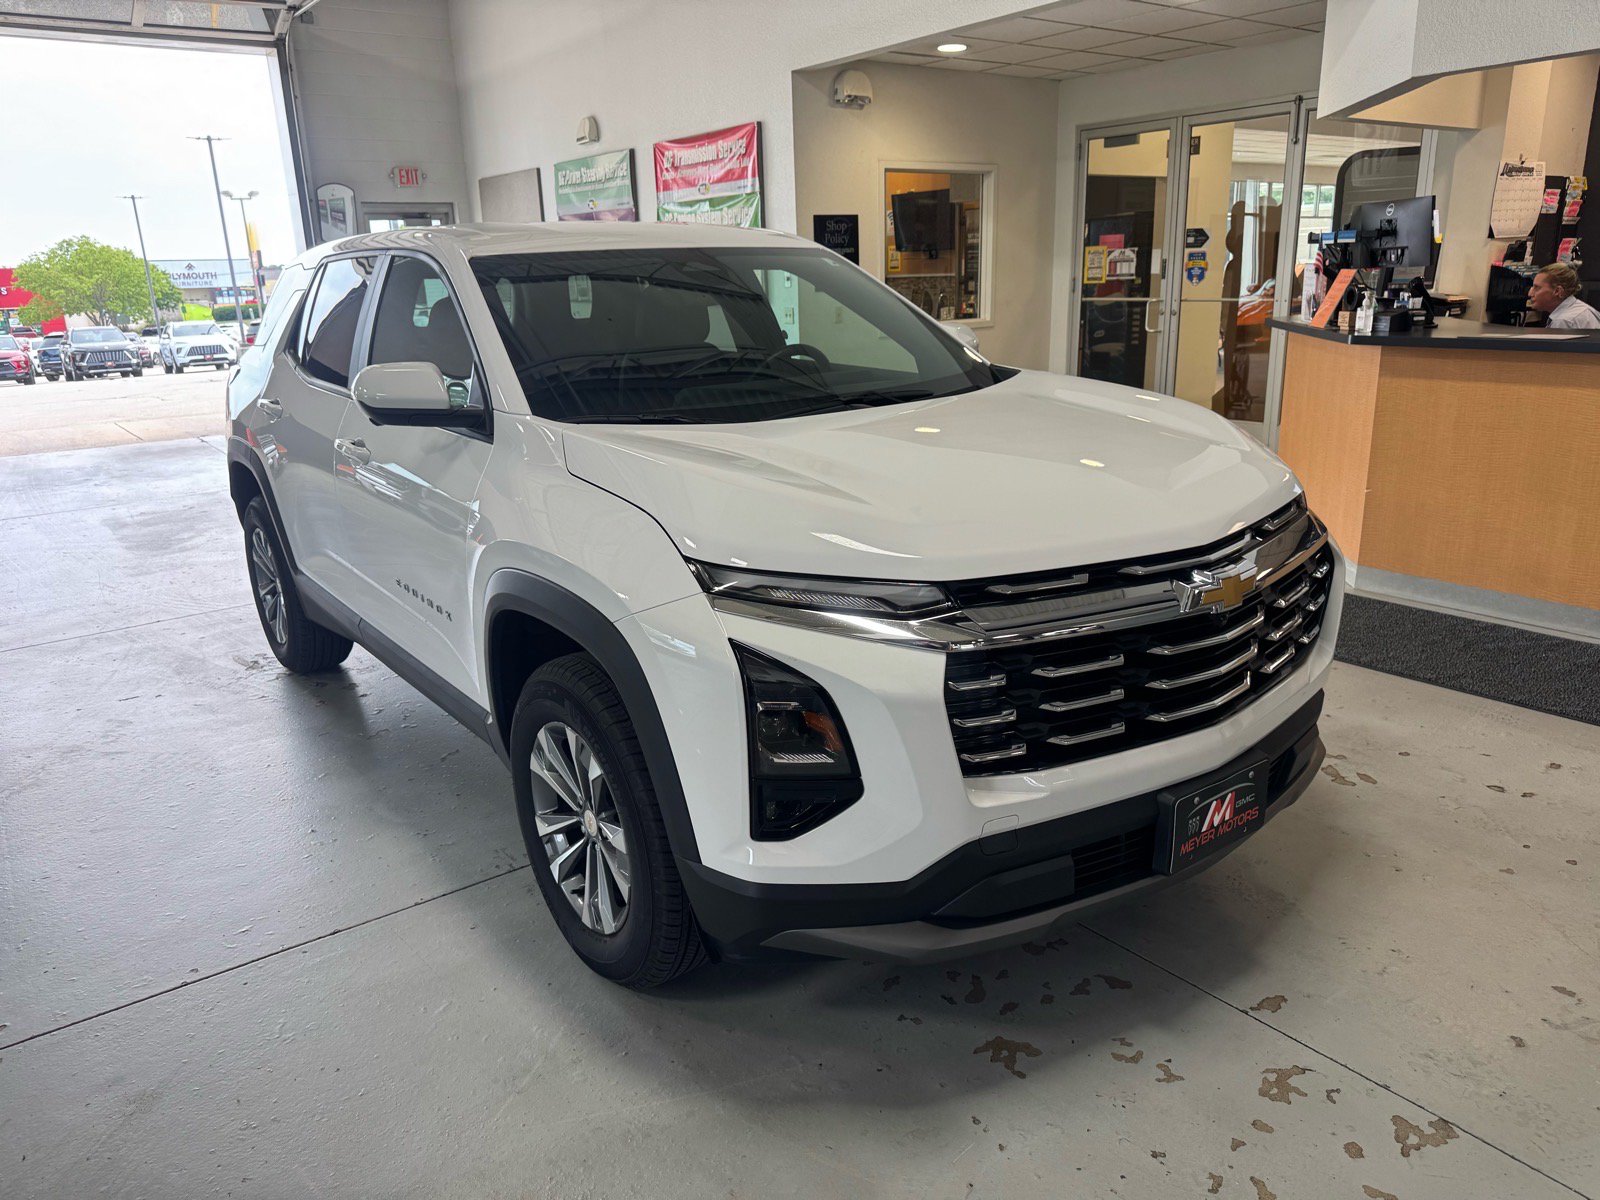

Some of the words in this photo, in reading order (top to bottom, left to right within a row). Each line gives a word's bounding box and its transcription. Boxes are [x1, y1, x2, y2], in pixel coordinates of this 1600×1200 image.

[674, 144, 717, 167] Transmission
[718, 137, 747, 158] Service
[399, 168, 419, 185] EXIT
[826, 220, 848, 234] Shop
[825, 233, 849, 247] Policy
[395, 578, 452, 622] EQUINOX
[1235, 793, 1256, 808] GMC
[1180, 829, 1216, 856] MEYER
[1217, 806, 1260, 837] MOTORS
